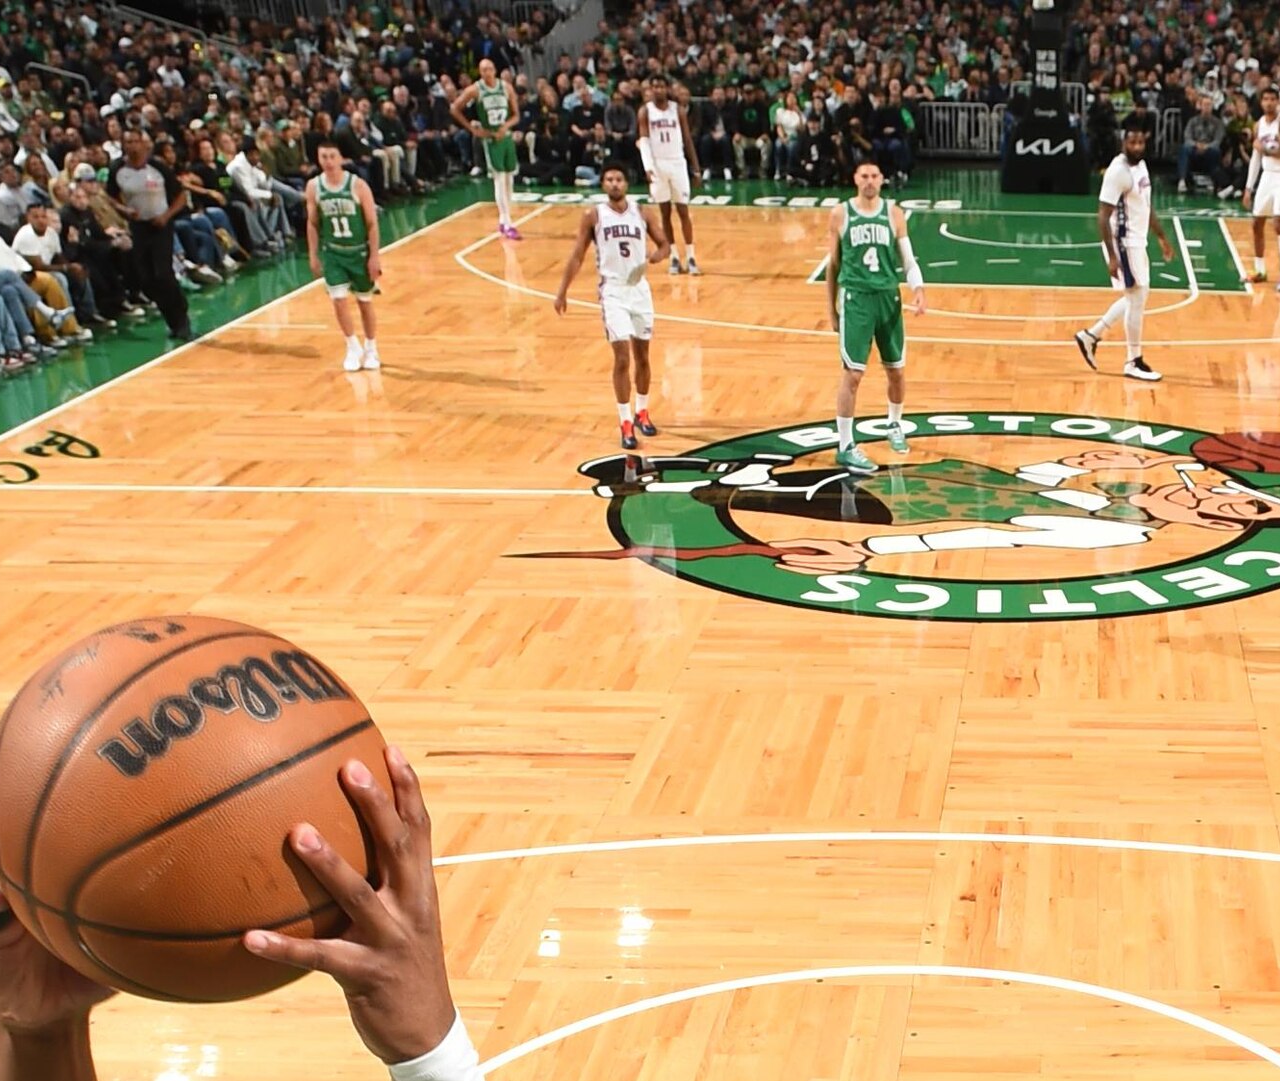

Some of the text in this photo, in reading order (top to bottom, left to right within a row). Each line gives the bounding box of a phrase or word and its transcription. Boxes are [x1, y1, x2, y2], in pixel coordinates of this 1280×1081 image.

[659, 131, 671, 144] 11
[1016, 138, 1075, 155] KIA
[510, 192, 963, 216] BOSTN CELCS
[331, 216, 354, 238] 11
[603, 224, 642, 241] PHILA
[850, 223, 891, 248] BOSTON
[619, 241, 632, 259] 5
[862, 246, 880, 273] 4
[778, 414, 1183, 448] BOSTON
[96, 649, 352, 779] Wilson
